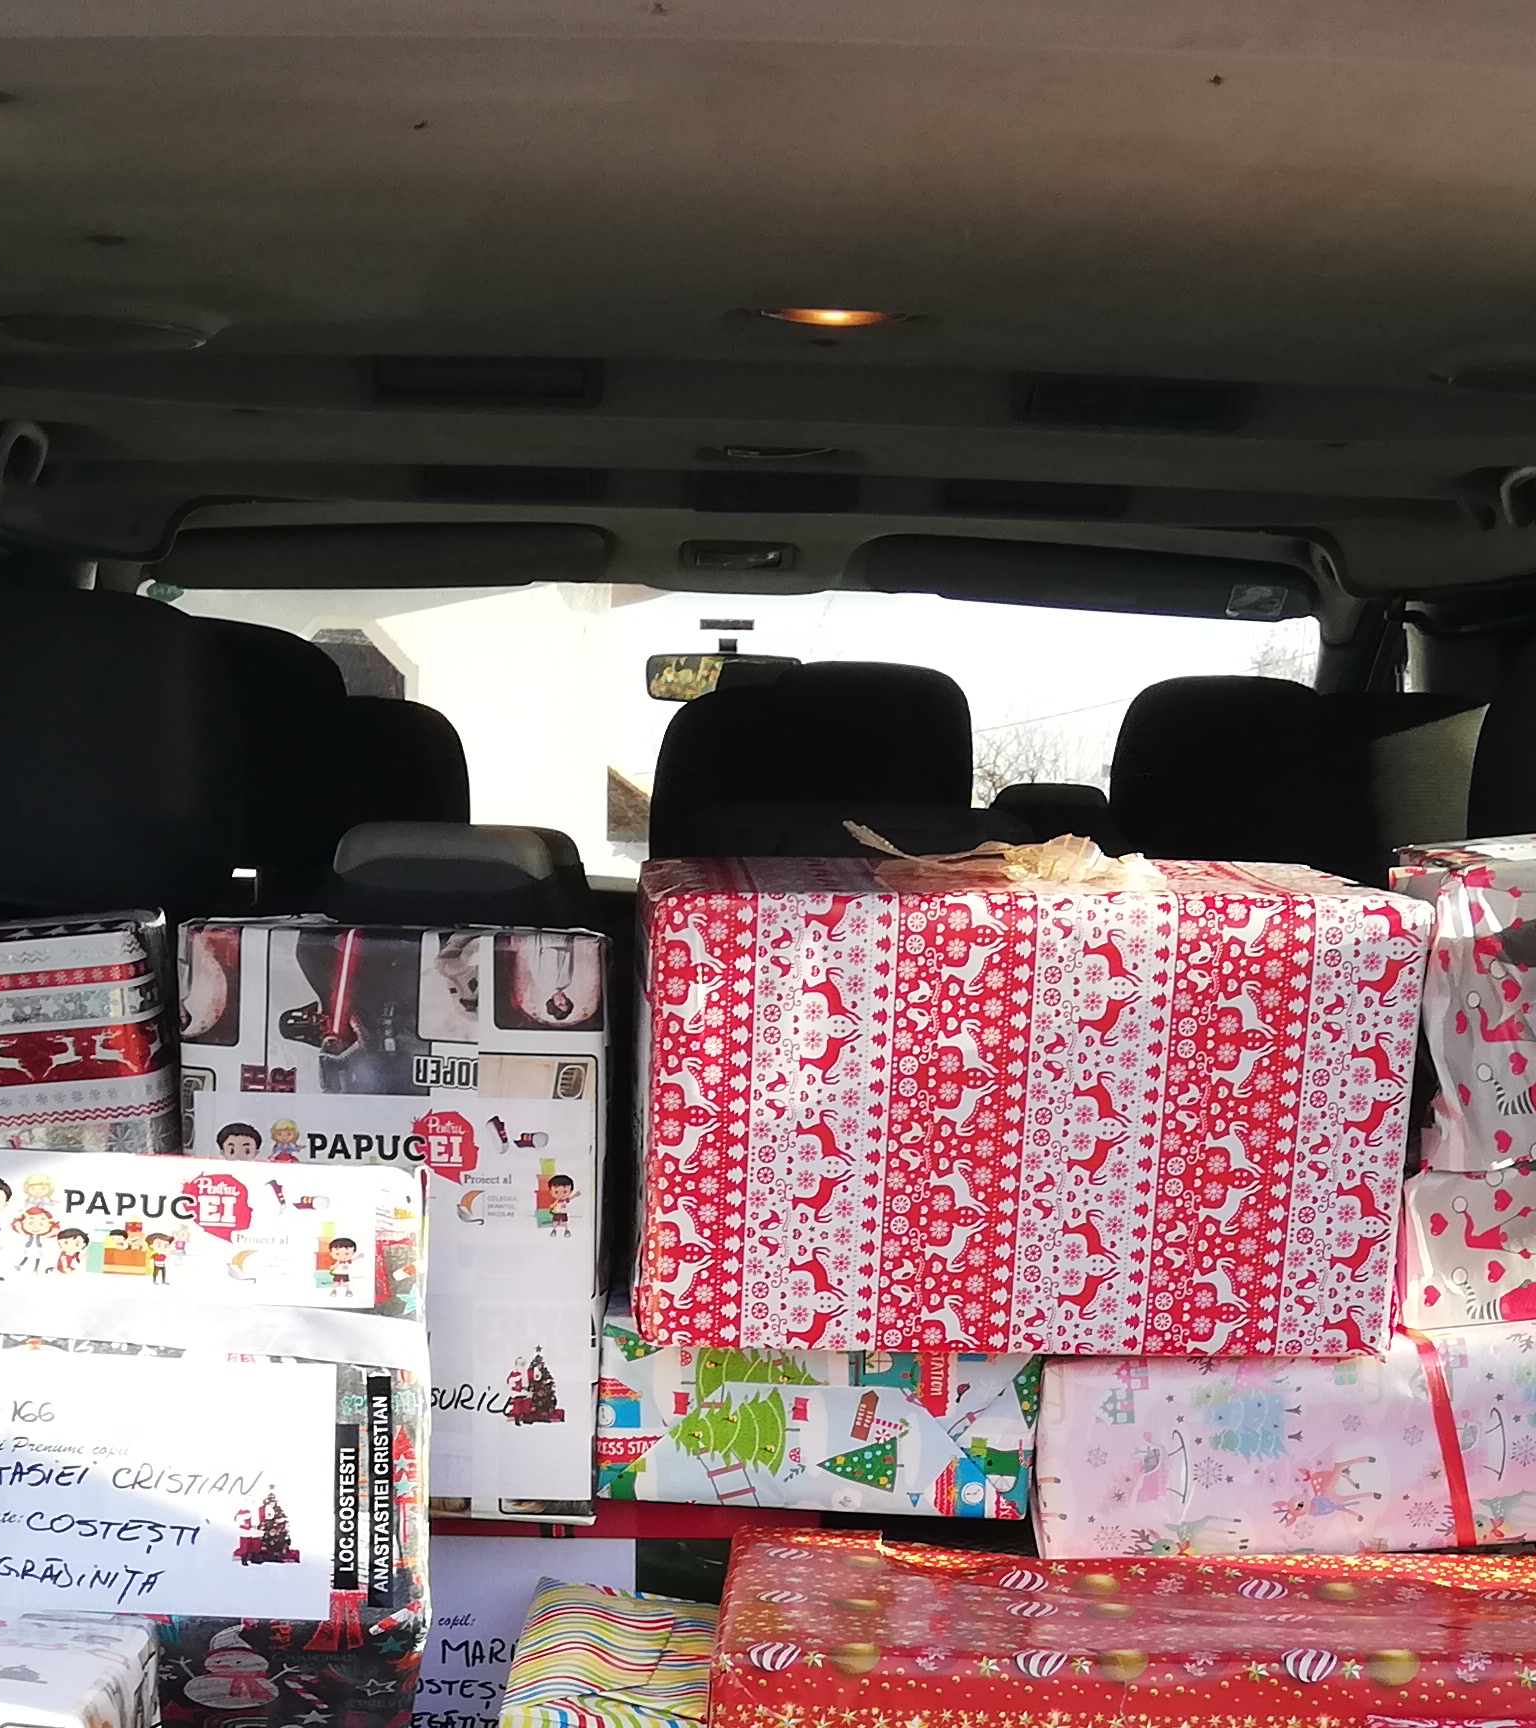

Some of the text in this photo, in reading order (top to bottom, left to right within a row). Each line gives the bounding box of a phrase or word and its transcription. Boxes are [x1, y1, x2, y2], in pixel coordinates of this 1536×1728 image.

[308, 1132, 464, 1164] PAPUCEI
[464, 1172, 512, 1186] Proiect al
[63, 1188, 238, 1224] PAPUCEI
[236, 1233, 274, 1246] Proiect
[11, 1437, 86, 1455] Prenume
[111, 1462, 264, 1497] CRISTIAN
[372, 1395, 390, 1593] ANASTASTIEI CRISTIAN
[438, 1614, 476, 1631] copil:
